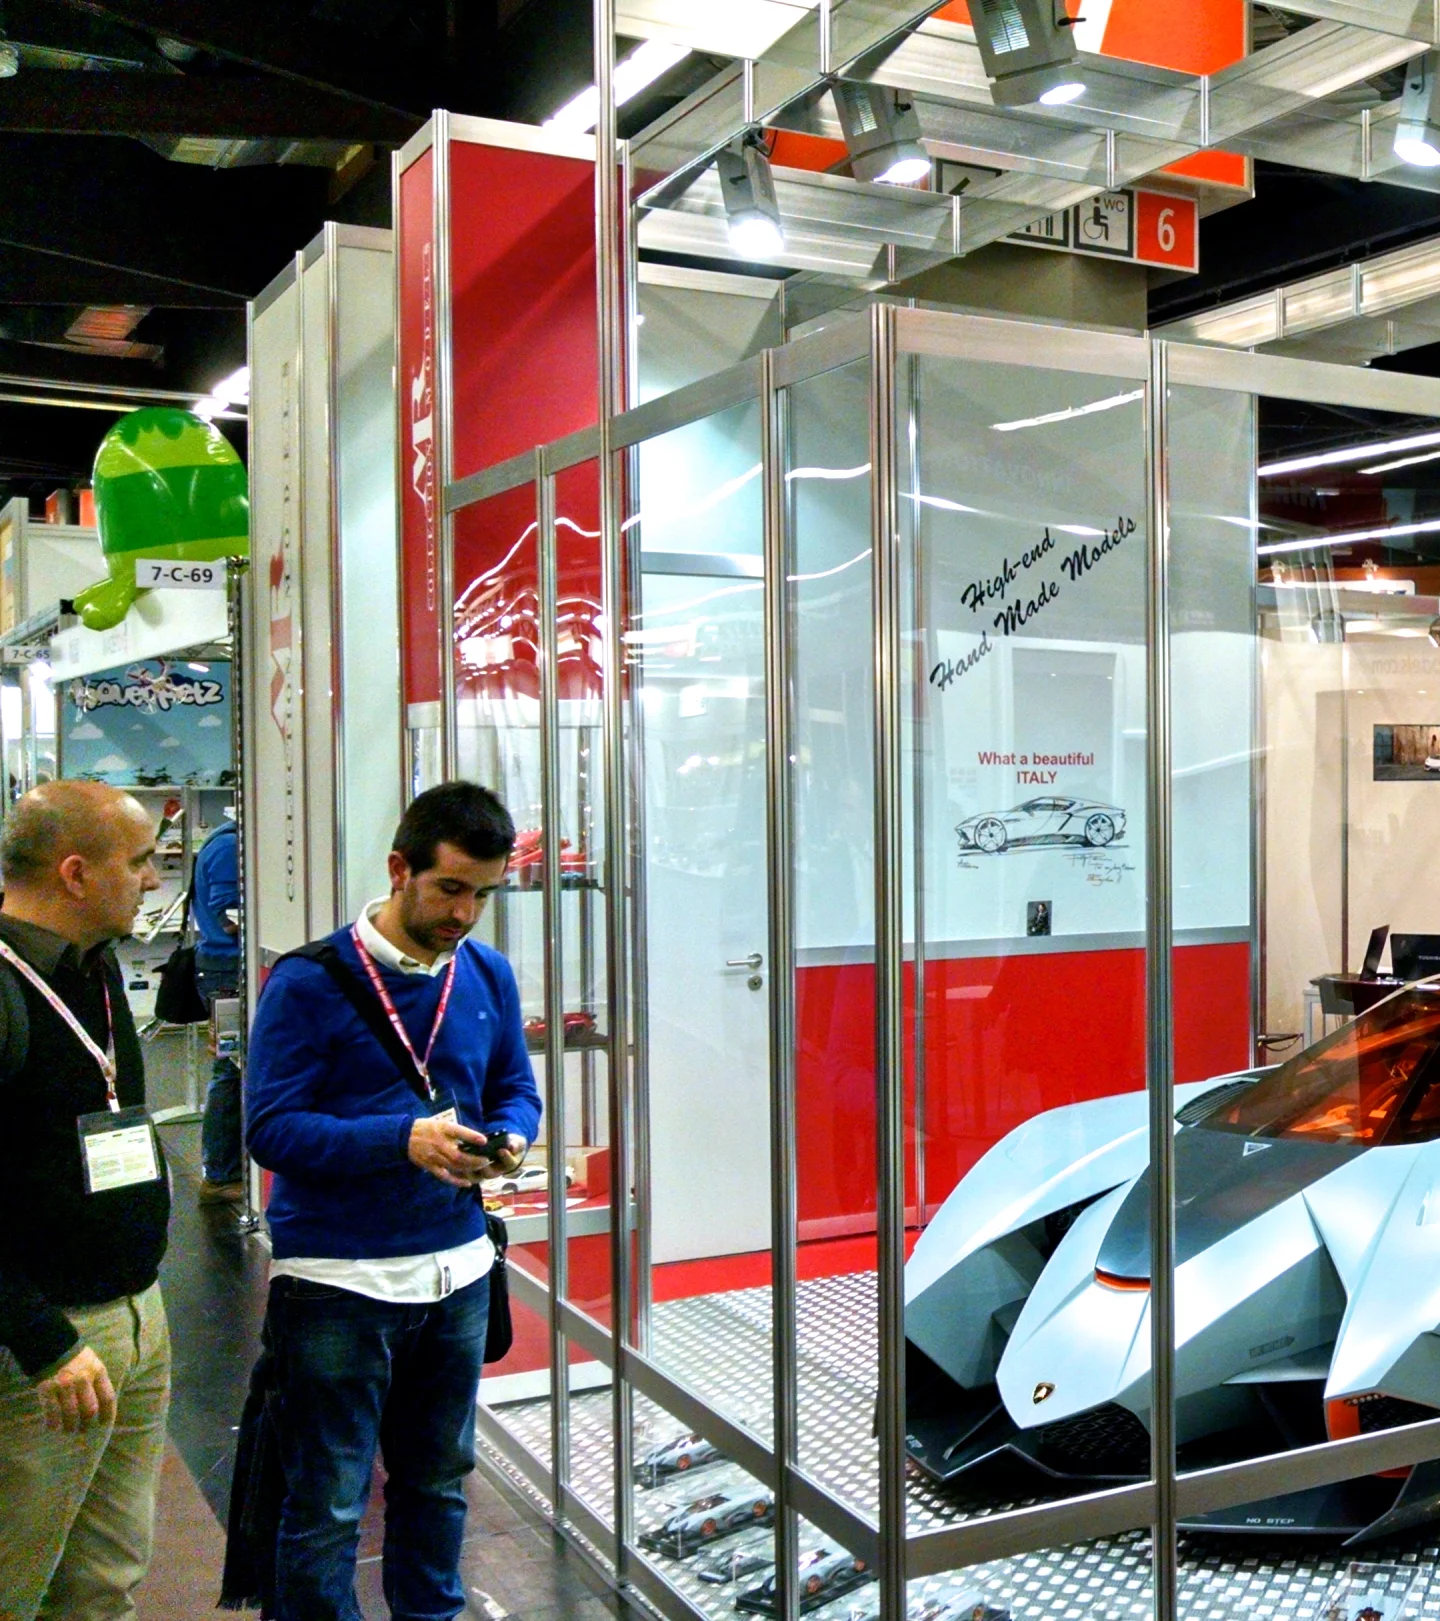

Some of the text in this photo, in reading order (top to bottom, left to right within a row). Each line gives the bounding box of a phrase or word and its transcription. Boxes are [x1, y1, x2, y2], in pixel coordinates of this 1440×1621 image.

[1103, 198, 1125, 212] WC
[1158, 208, 1175, 251] 6
[151, 566, 213, 583] 7-C-69
[961, 527, 1056, 613] High-end
[929, 516, 1137, 692] Hand Made Models
[12, 649, 50, 659] 7-C-65
[977, 752, 1094, 765] What a beautiful
[1016, 771, 1058, 784] ITALY
